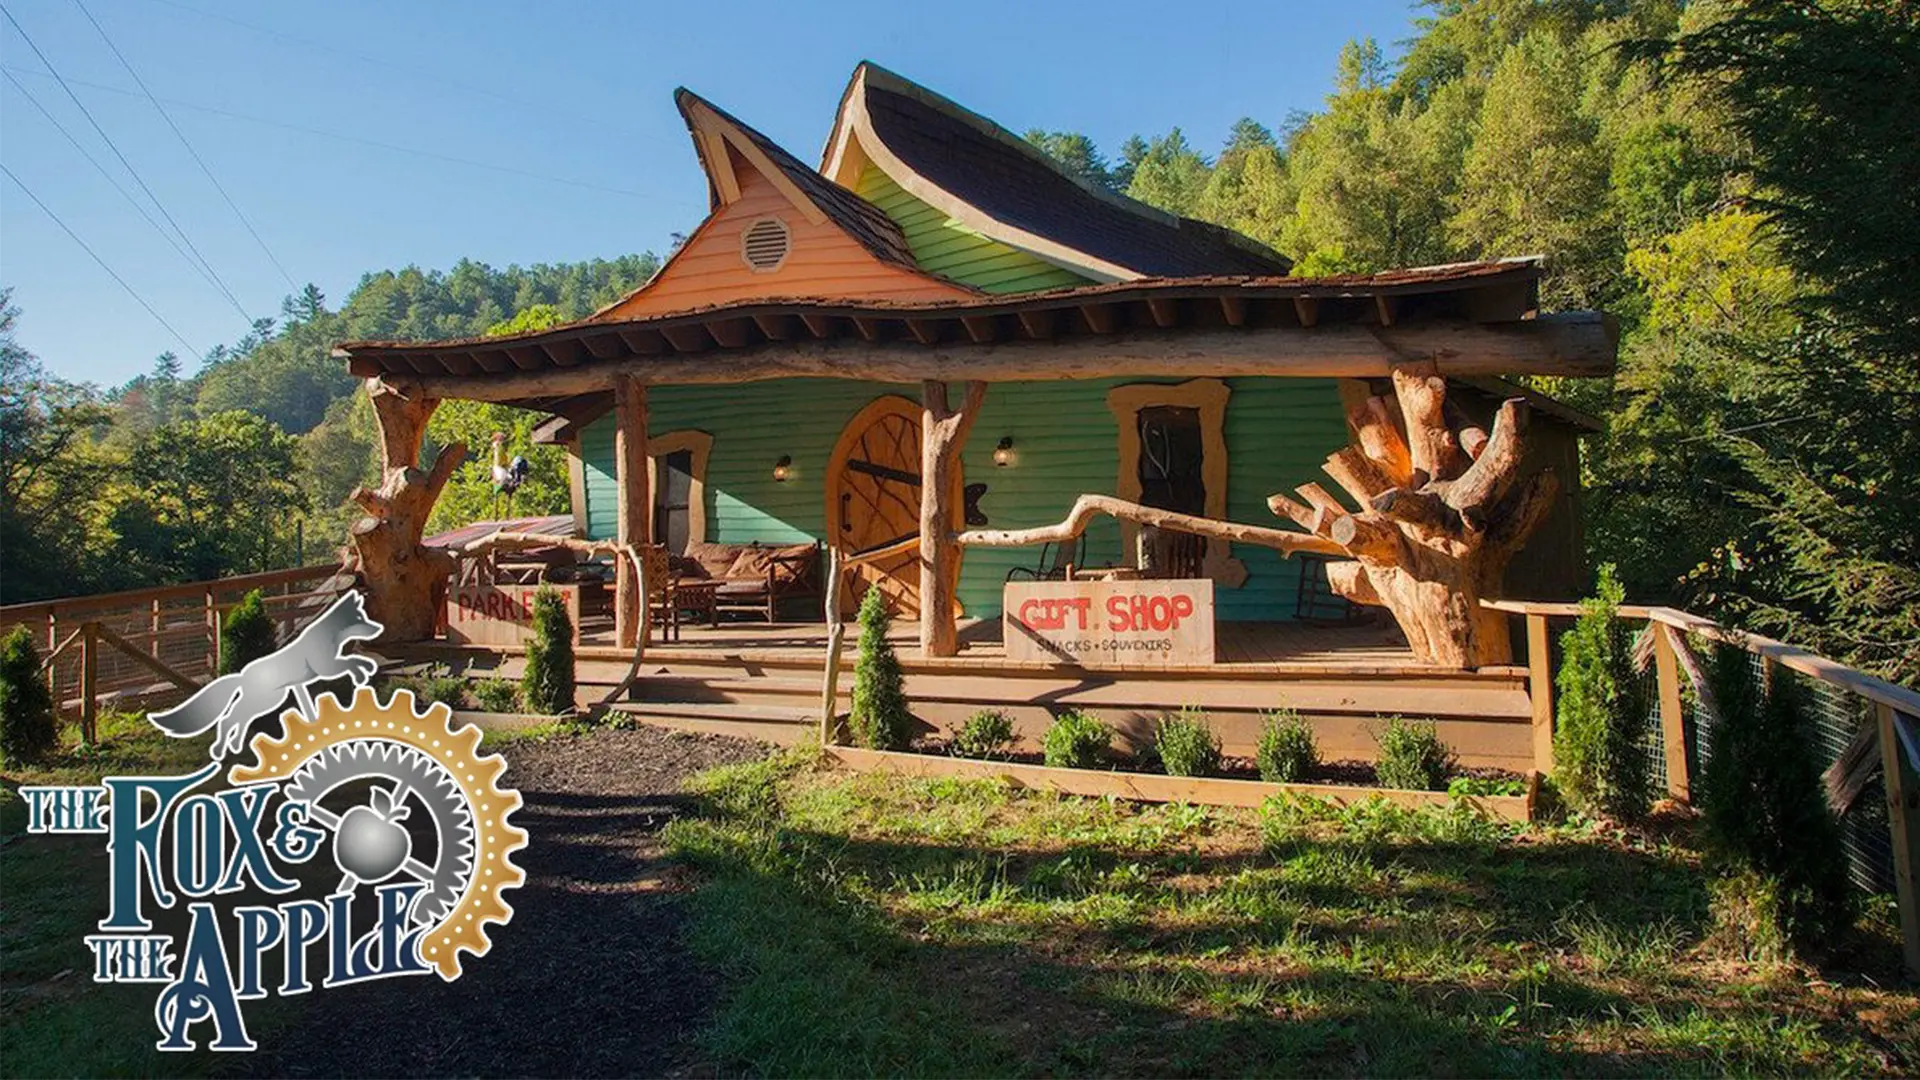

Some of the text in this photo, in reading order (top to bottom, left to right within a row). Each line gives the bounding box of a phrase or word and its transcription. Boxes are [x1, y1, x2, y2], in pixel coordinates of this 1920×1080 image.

[458, 591, 517, 622] PARK
[1019, 594, 1193, 632] GIFT SHOP
[1037, 638, 1172, 652] SNACKS SOUVENIRS
